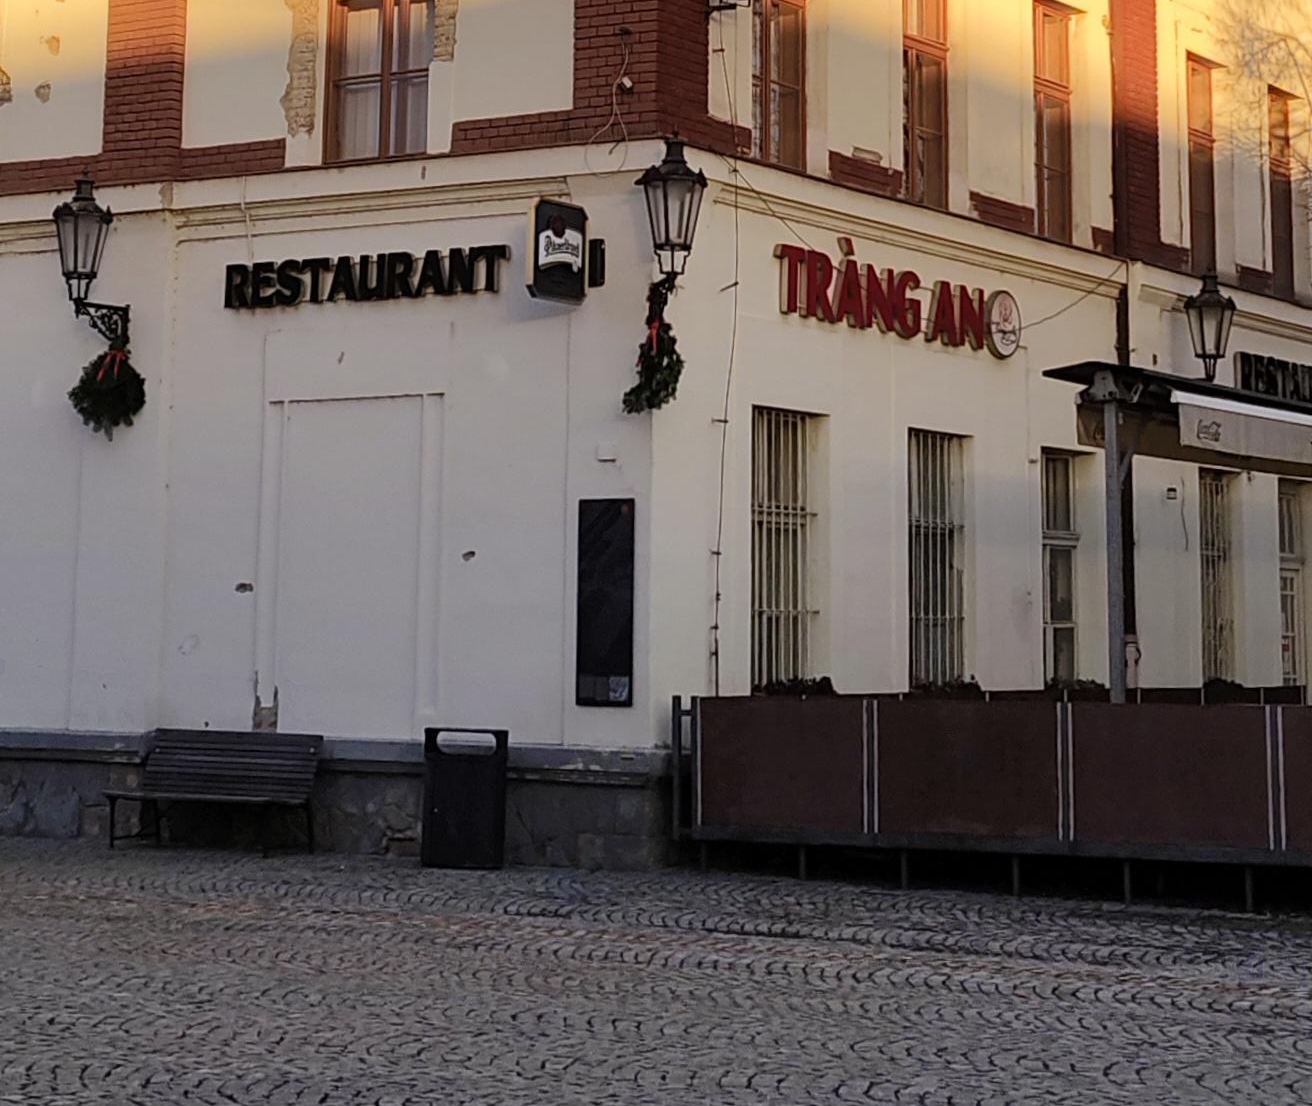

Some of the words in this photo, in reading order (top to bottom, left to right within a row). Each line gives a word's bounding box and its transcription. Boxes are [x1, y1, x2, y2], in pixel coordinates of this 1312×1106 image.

[224, 244, 511, 309] RESTAURANT
[774, 237, 921, 339] TRÀNG
[925, 280, 985, 350] AN
